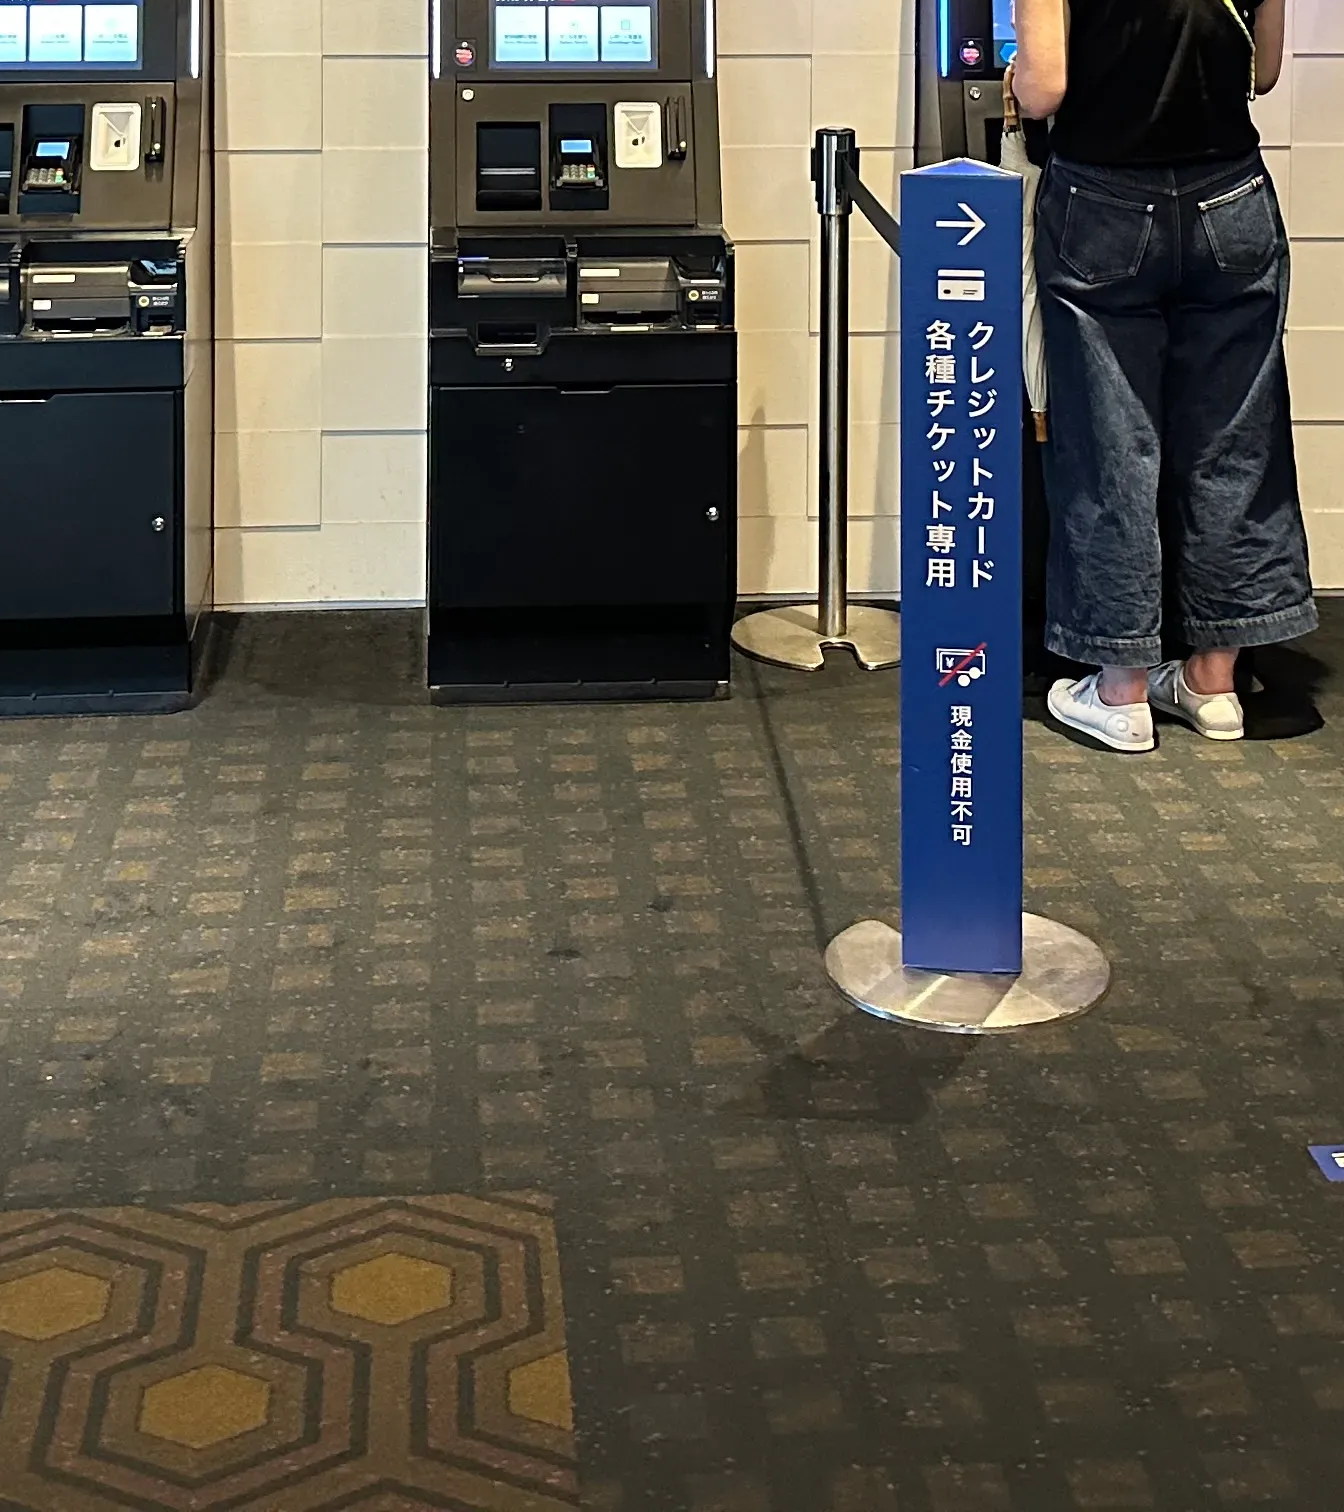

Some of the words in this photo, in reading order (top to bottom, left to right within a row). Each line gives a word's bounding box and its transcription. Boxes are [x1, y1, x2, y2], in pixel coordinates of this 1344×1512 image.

[925, 319, 956, 588] 各種チケット専用
[967, 320, 997, 589] クレジットカード
[950, 704, 973, 846] 現金使用不可
